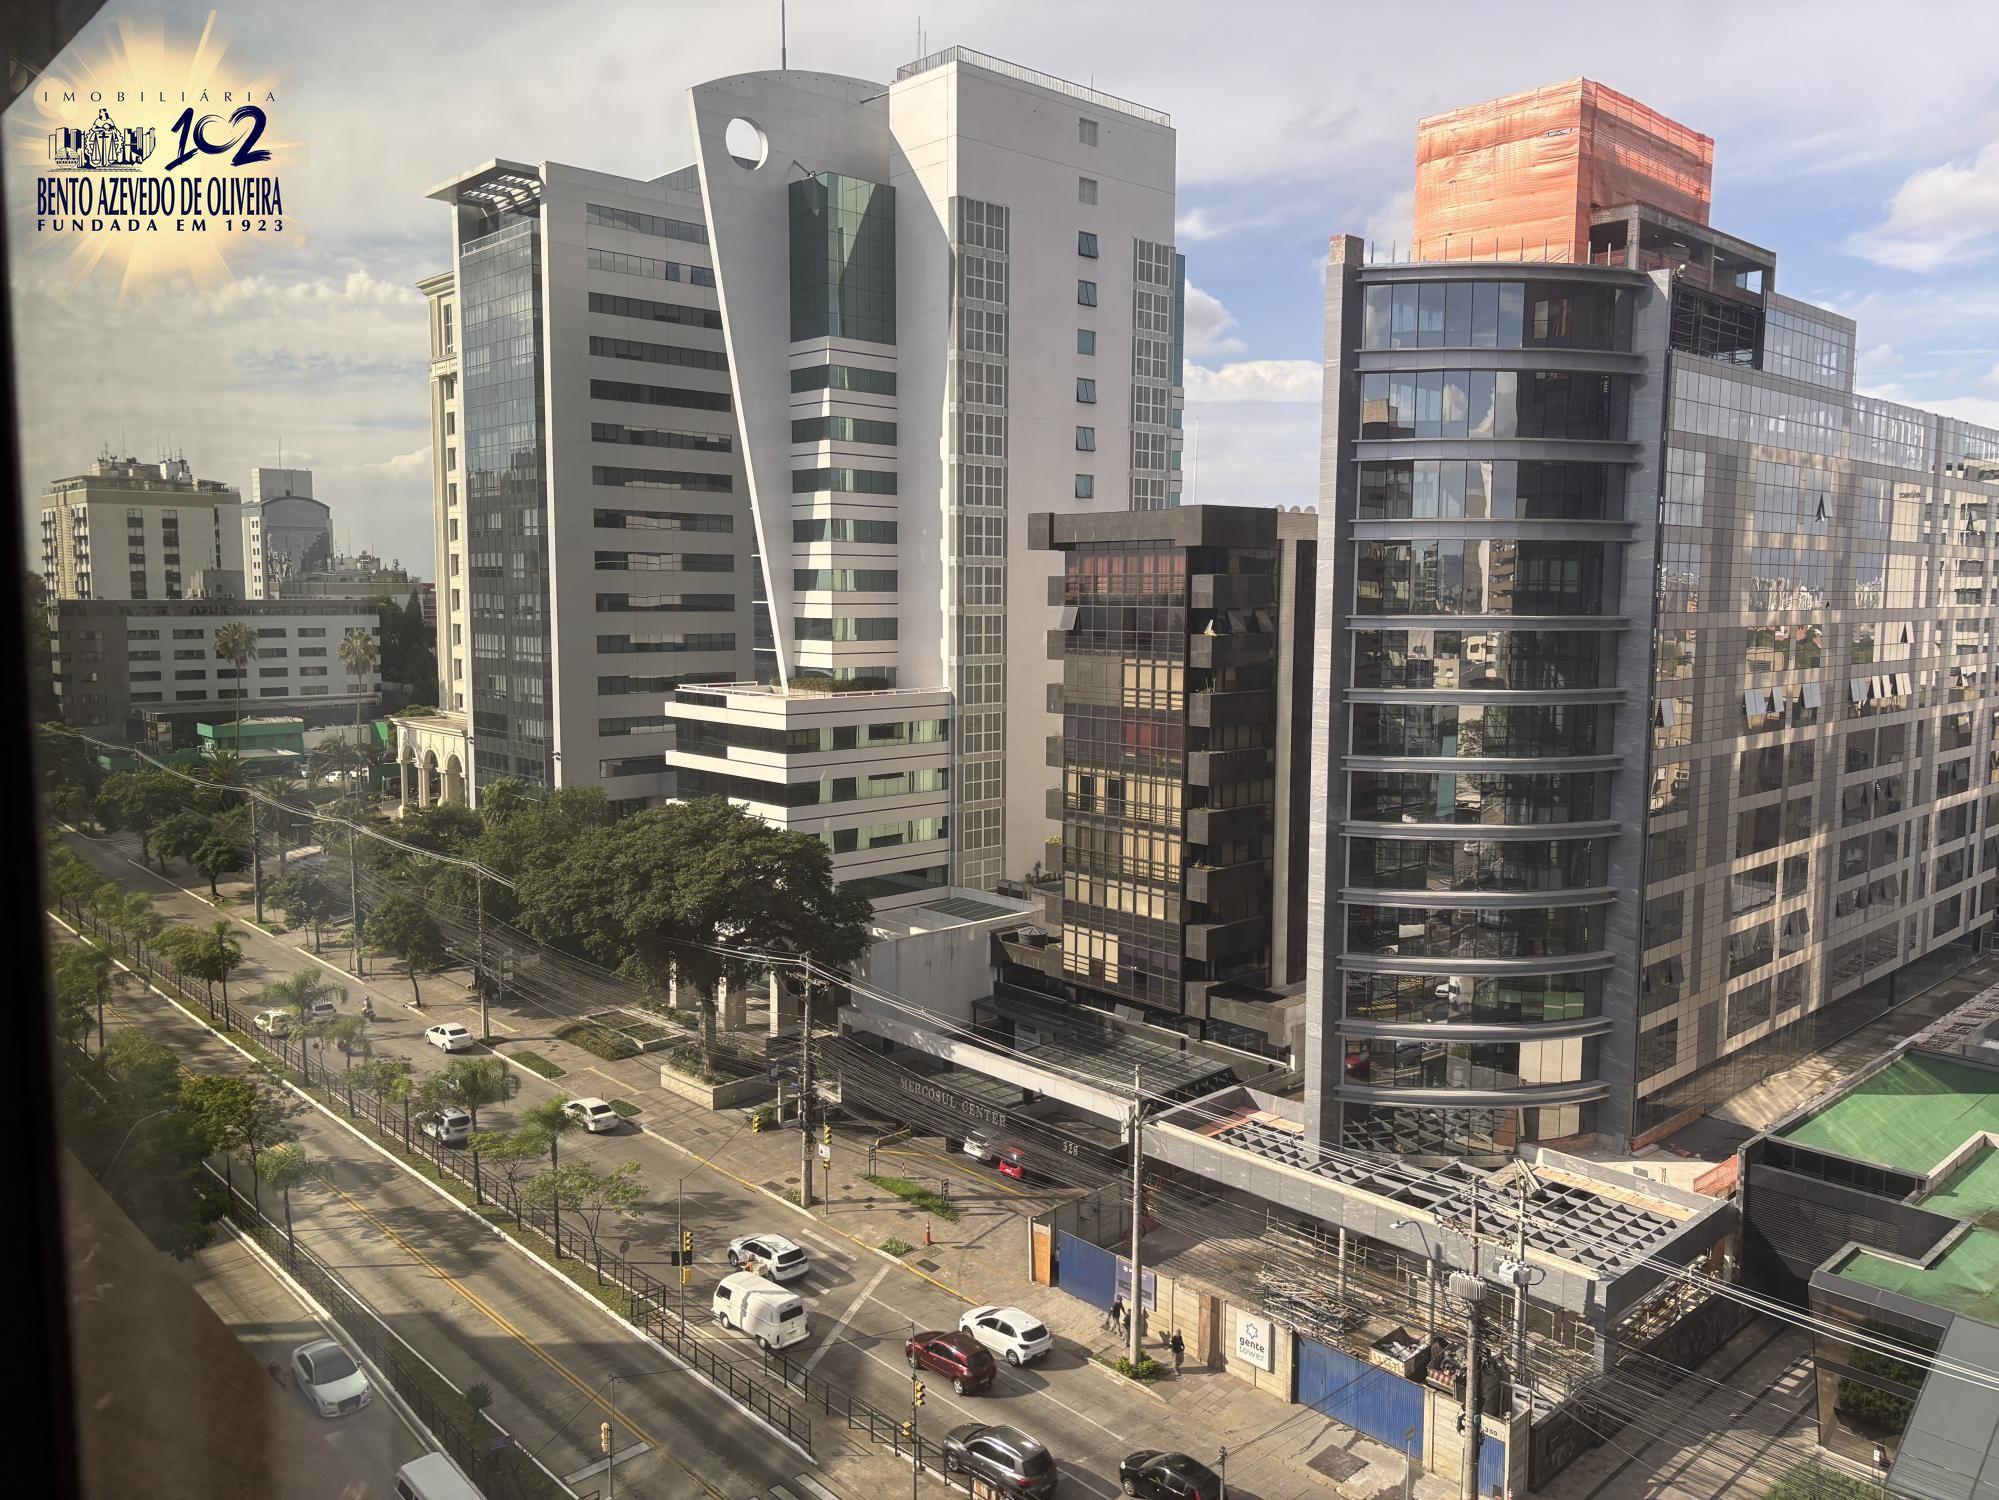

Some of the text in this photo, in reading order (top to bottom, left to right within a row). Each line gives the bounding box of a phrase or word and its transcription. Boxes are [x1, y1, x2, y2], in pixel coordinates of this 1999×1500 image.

[900, 1077, 1006, 1128] MERCOSUL CENTER
[1239, 1336, 1265, 1354] gente
[1239, 1345, 1265, 1362] tower
